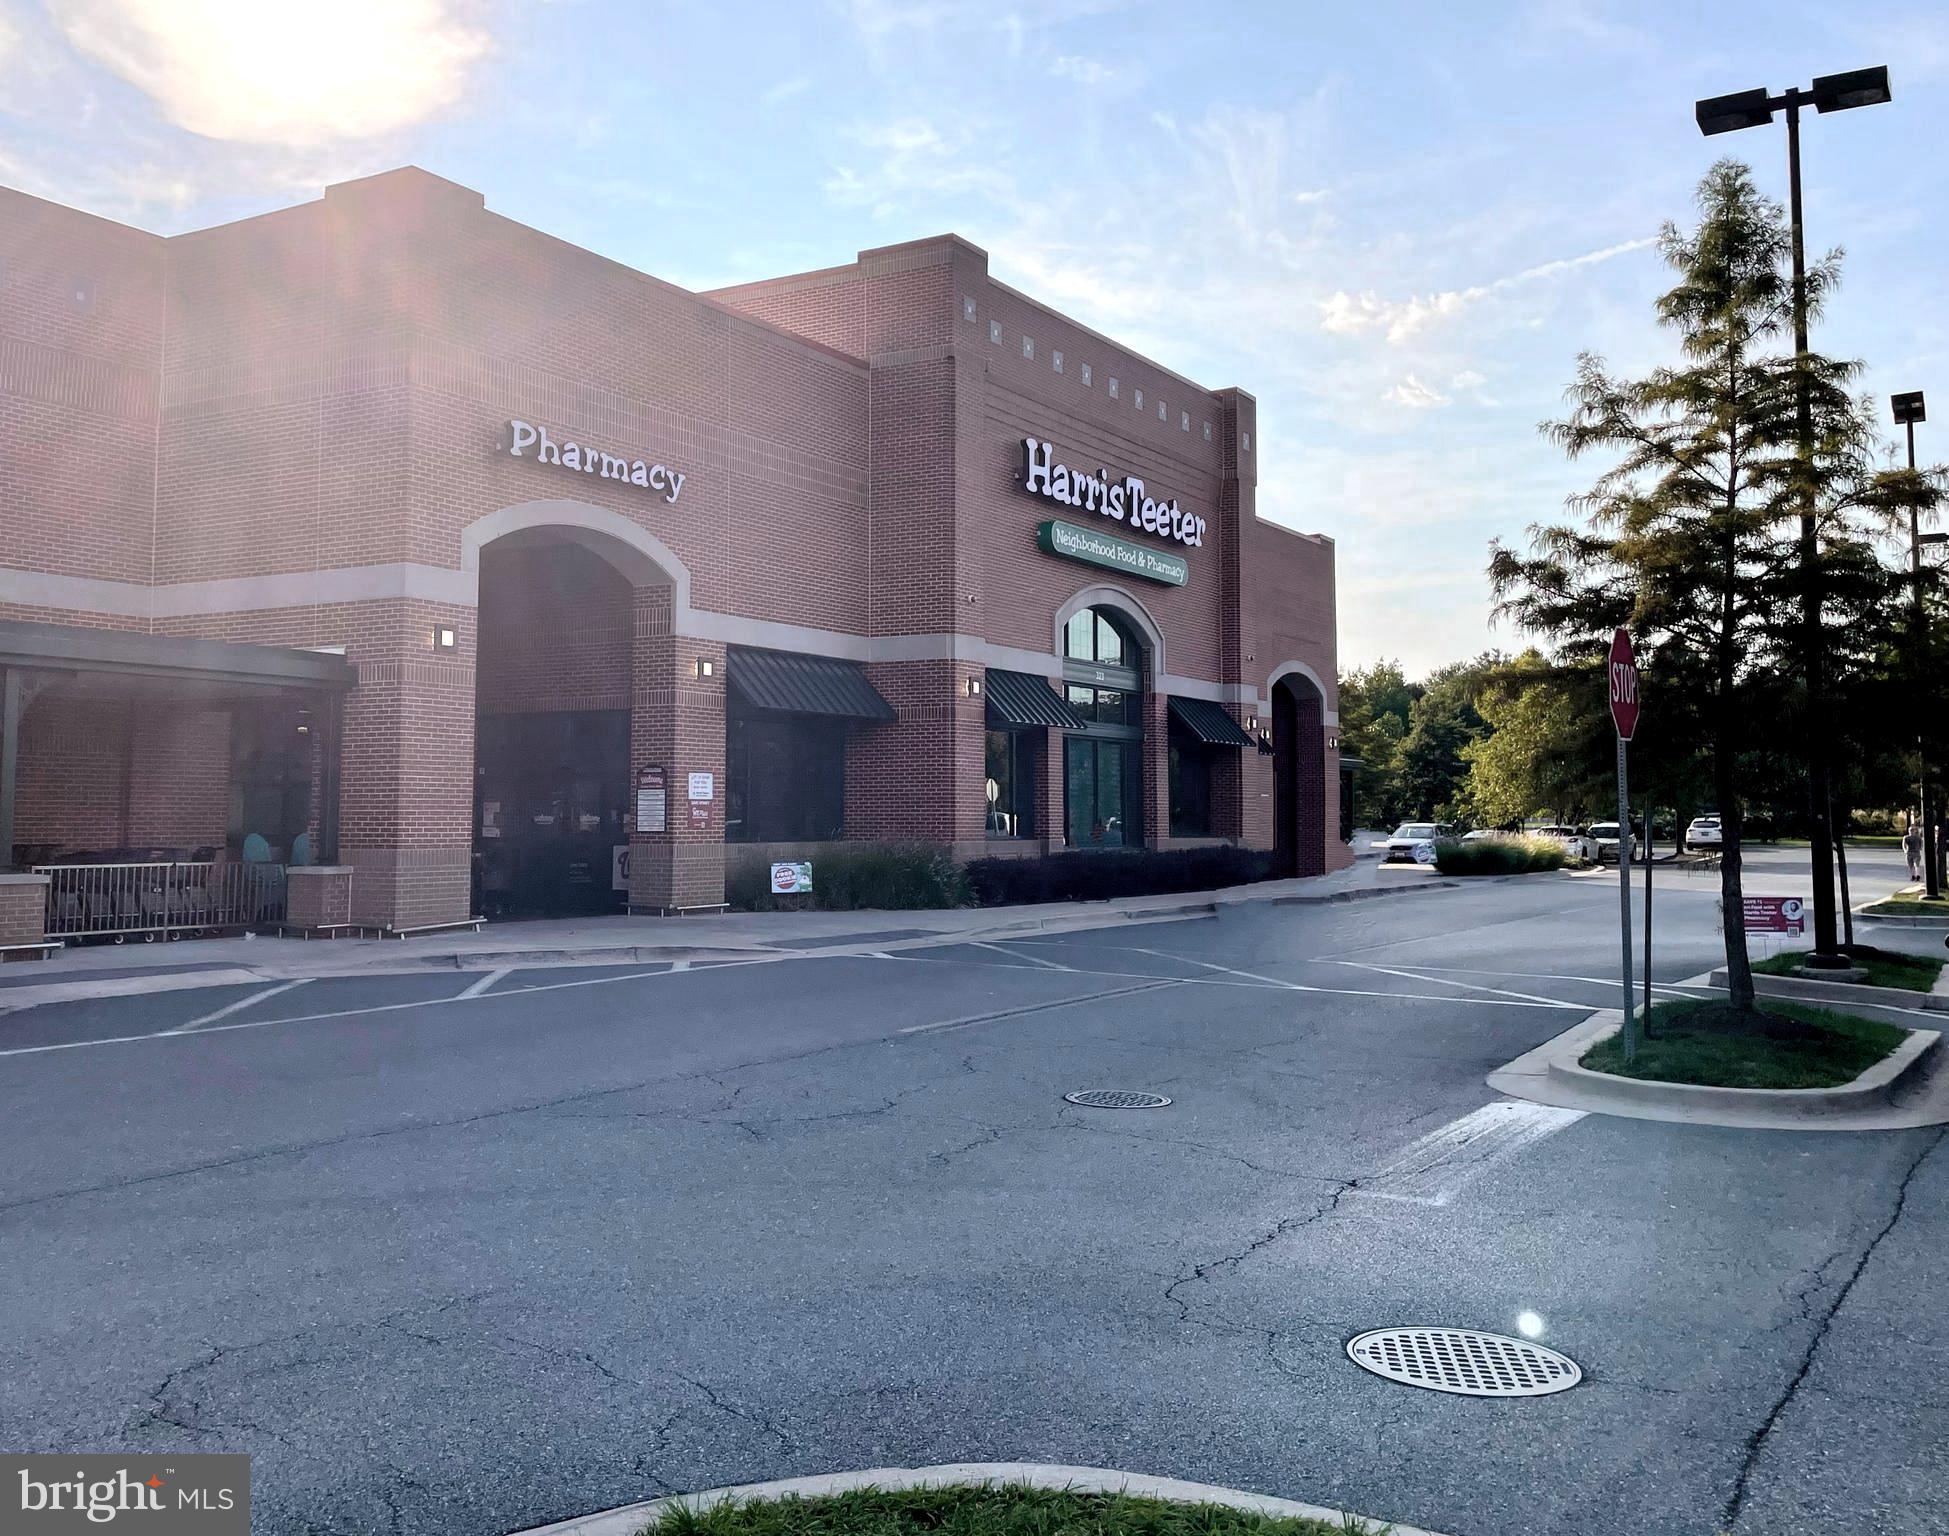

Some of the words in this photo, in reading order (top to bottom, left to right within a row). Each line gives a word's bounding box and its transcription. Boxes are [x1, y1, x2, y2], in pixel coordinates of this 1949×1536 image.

[510, 420, 686, 504] Pharmacy
[1025, 438, 1125, 521] Harris
[1126, 476, 1206, 547] Teeter
[1056, 528, 1116, 559] Neighborhood
[1116, 547, 1137, 566] Food
[1138, 552, 1146, 567] &
[1146, 555, 1185, 583] Pharmacy
[1612, 661, 1636, 704] STOP
